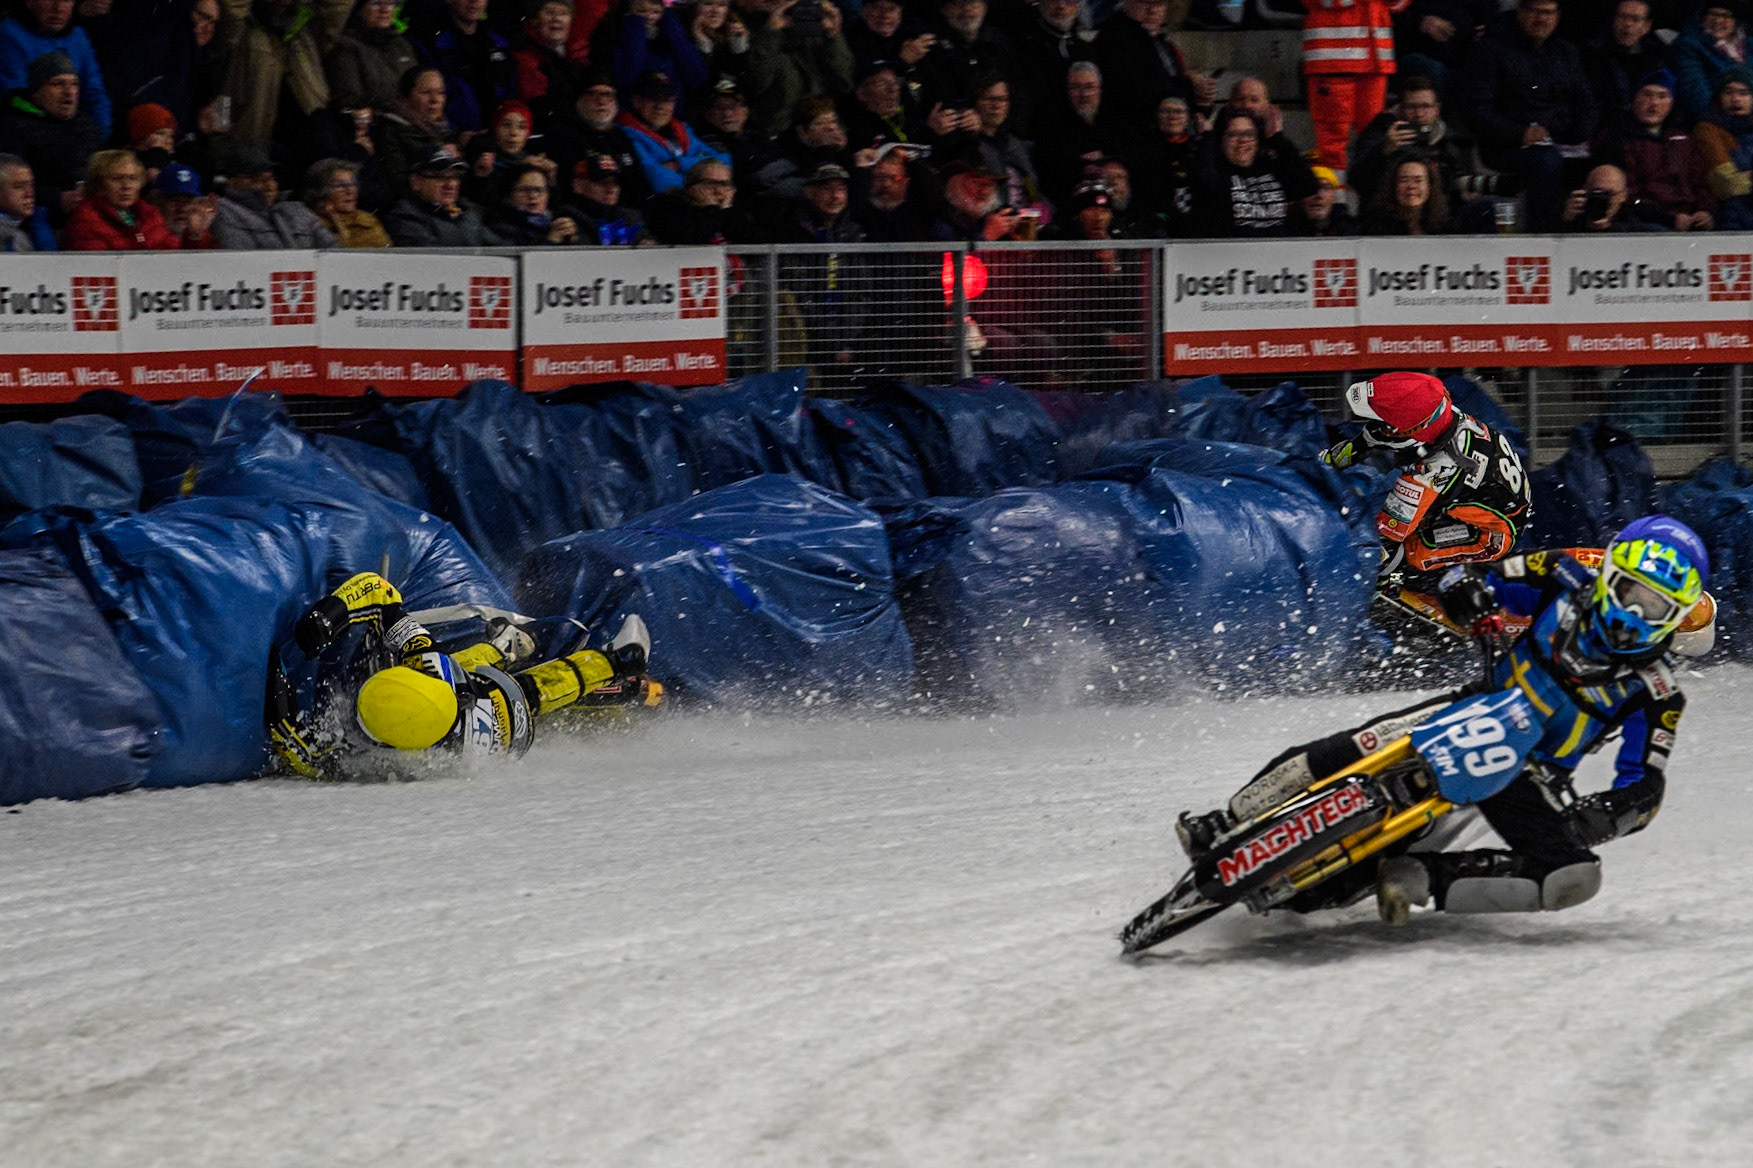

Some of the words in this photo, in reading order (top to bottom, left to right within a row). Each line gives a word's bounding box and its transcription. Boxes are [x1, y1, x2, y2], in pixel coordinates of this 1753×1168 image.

[1175, 268, 1238, 303] Josef
[1242, 267, 1310, 295] Fuchs
[1368, 263, 1429, 296] Josef
[1434, 263, 1501, 290] Fuchs
[1568, 262, 1631, 296] Josef
[1636, 262, 1702, 289] Fuchs
[0, 285, 67, 314] Fuchs
[129, 282, 192, 321] Josef
[197, 280, 265, 311] Fuchs
[328, 282, 394, 317] Josef
[397, 283, 464, 312] Fuchs
[534, 277, 606, 315] Josef
[609, 276, 676, 305] Fuchs
[1174, 341, 1256, 361] Menschen.
[1258, 341, 1310, 358] Bauen.
[1311, 339, 1360, 356] Werte.
[1368, 335, 1449, 354] Menschen.
[1450, 335, 1502, 352] Bauen.
[1503, 335, 1552, 352] Werte.
[1567, 334, 1650, 351] Menschen.
[1652, 333, 1703, 350] Bauen.
[1704, 332, 1753, 349] Werte.
[19, 367, 74, 386] Bauen.
[73, 366, 123, 386] Werte.
[131, 364, 214, 386] Menschen.
[268, 360, 318, 379] Werte.
[327, 361, 408, 380] Menschen.
[410, 362, 461, 380] Bauen.
[462, 362, 511, 380] Werte.
[532, 355, 620, 376] Menschen.
[623, 354, 674, 374] Bauen.
[675, 352, 720, 371] Werte.
[1216, 783, 1369, 886] MACHTECH
